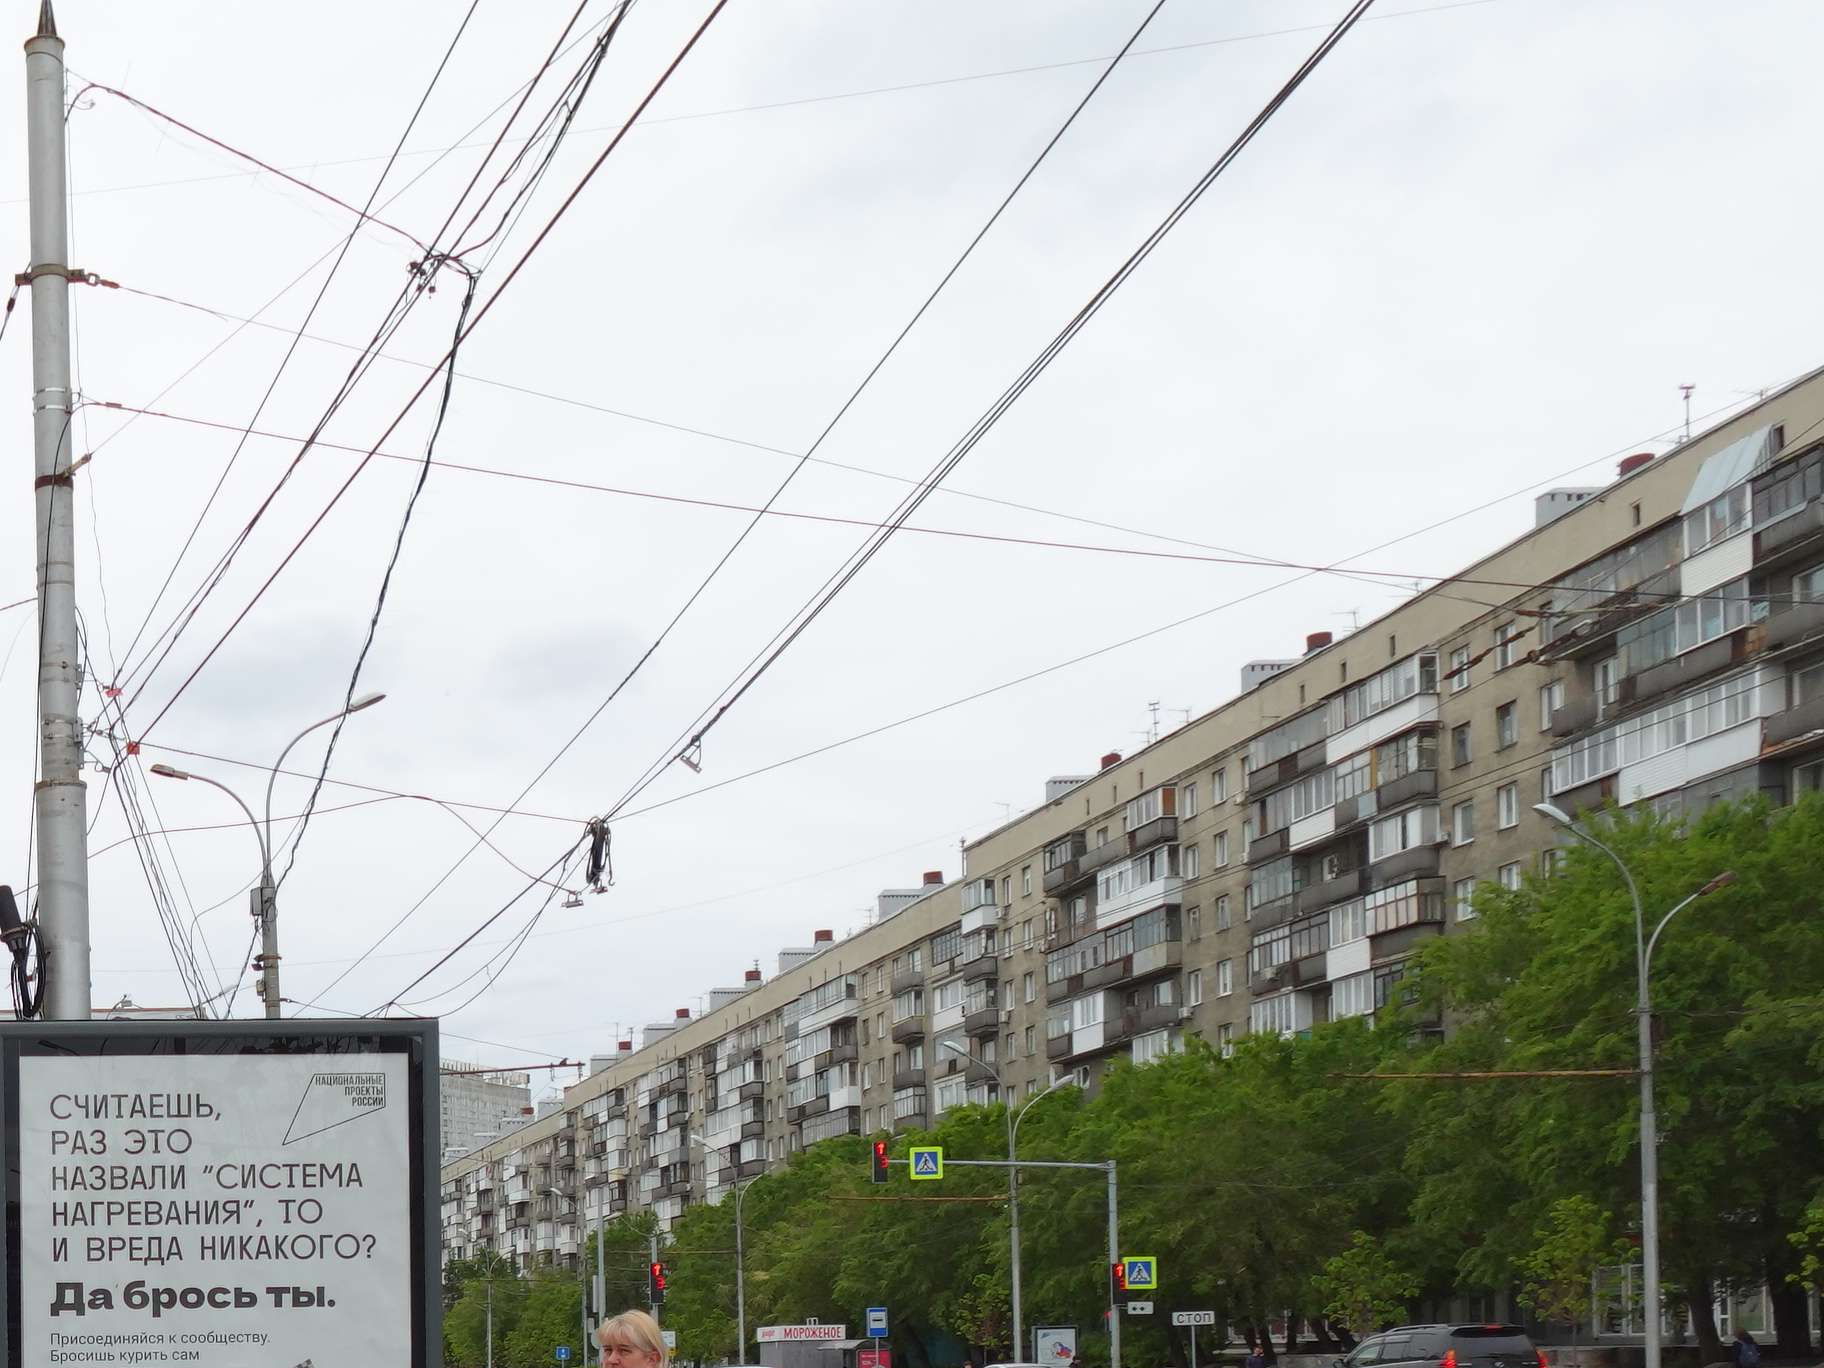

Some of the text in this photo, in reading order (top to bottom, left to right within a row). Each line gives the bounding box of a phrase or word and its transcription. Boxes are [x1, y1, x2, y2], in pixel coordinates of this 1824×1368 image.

[315, 1075, 383, 1087] НАЦИОНАЛЬНЫЕ
[344, 1086, 383, 1096] ПРОЕКТЫ
[50, 1093, 221, 1121] СЧИТАЕШЬ,
[352, 1096, 383, 1107] РОССИИ
[51, 1129, 193, 1155] РАЗ ЭТО
[52, 1165, 186, 1191] НАЗВАЛИ
[278, 1199, 323, 1224] ТО
[53, 1234, 376, 1266] И ВРЕДА НИКАКОГО?
[50, 1280, 336, 1317] Да брось ты.
[1177, 1313, 1211, 1324] СТОП
[50, 1331, 271, 1346] Присоединяйся к сообществу.
[784, 1327, 841, 1338] МОРОЖЕНОЕ
[50, 1350, 200, 1364] Бросишь курить сам
